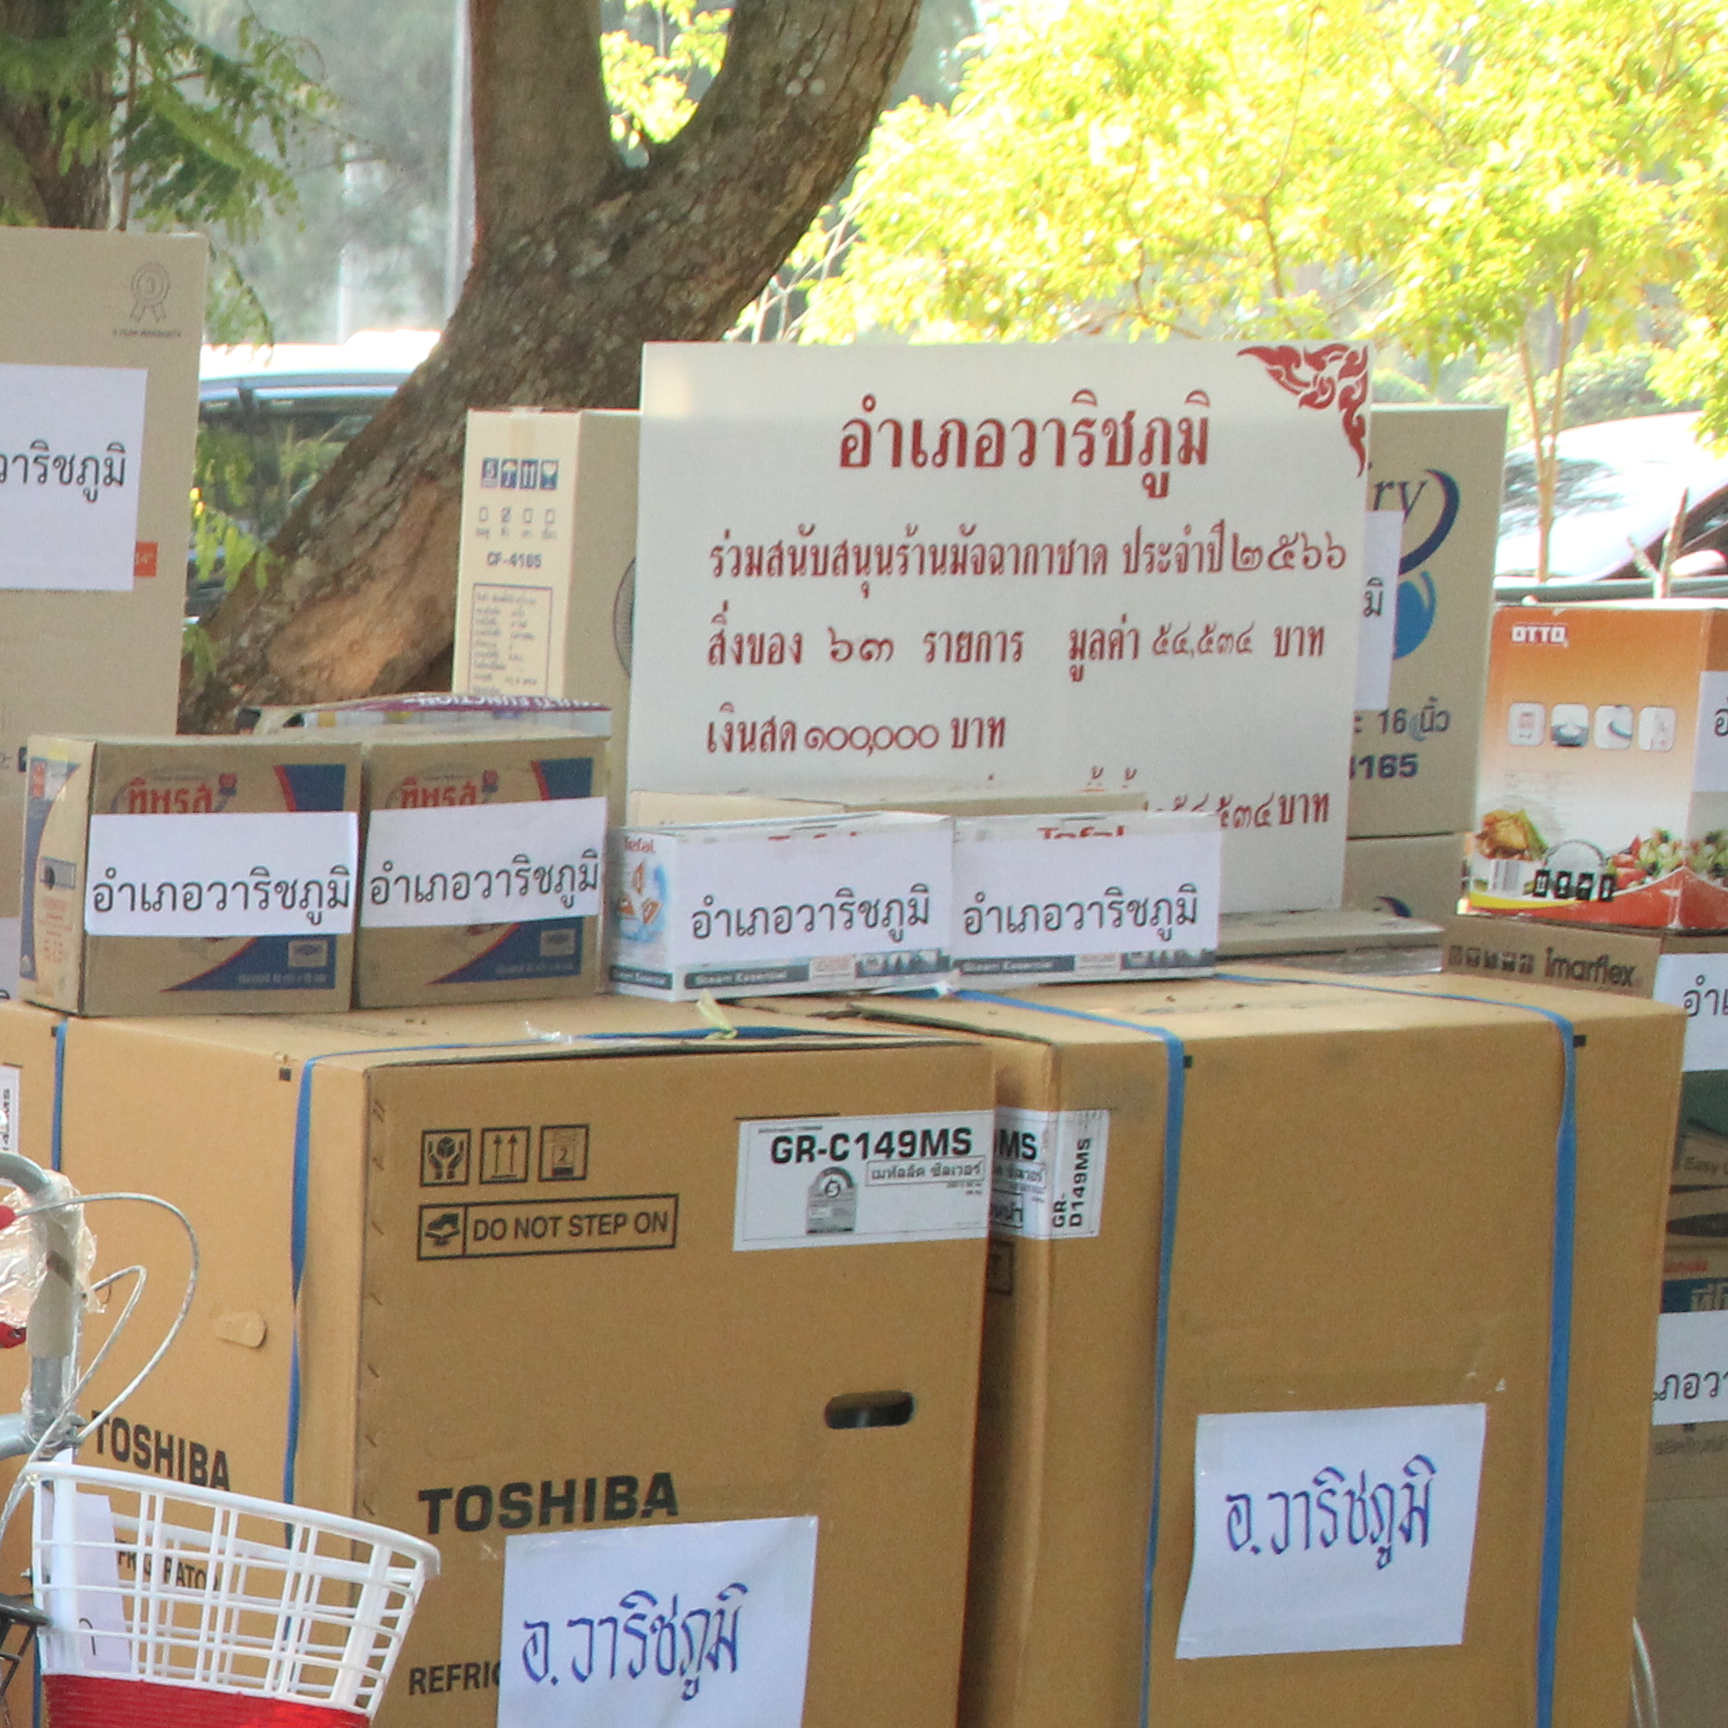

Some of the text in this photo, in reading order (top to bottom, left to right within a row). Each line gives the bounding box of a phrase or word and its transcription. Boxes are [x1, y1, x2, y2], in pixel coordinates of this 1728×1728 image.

[839, 388, 1210, 499] อำเภอวาริชภูมิ
[710, 522, 1108, 599] ร่วมสนับสนุนร้านมัจฉากาชาด
[707, 600, 804, 668] สิ่งของ
[828, 627, 895, 664] ๖๓
[923, 626, 1025, 664] รายการ
[1067, 613, 1141, 684] มูลค่า
[1273, 622, 1326, 658] บาท
[1511, 624, 1567, 645] OTTO
[706, 702, 798, 755] เงินสด
[951, 715, 1007, 751] บาท
[1379, 696, 1450, 733] 16 นิ้ว
[1279, 791, 1331, 827] บาท
[93, 866, 350, 925] อำเภอวาริชภูมิ
[370, 849, 599, 908] อำเภอวาริชภูมิ
[691, 885, 931, 942] อำเภอวาริชภูมิ
[963, 884, 1198, 940] อำเภอวาริชภูมิ
[1545, 947, 1638, 988] imarflex
[771, 1127, 973, 1164] GR-C149MS
[1052, 1193, 1067, 1228] GR-
[1070, 1137, 1092, 1227] D149MS
[473, 1210, 670, 1242] DO NOT STEP ON
[91, 1409, 232, 1492] TOSHIBA
[419, 1472, 679, 1535] TOSHIBA
[1225, 1453, 1438, 1568] อ.วาริชภูมิ
[521, 1581, 749, 1700] อ.วาริชภูมิ
